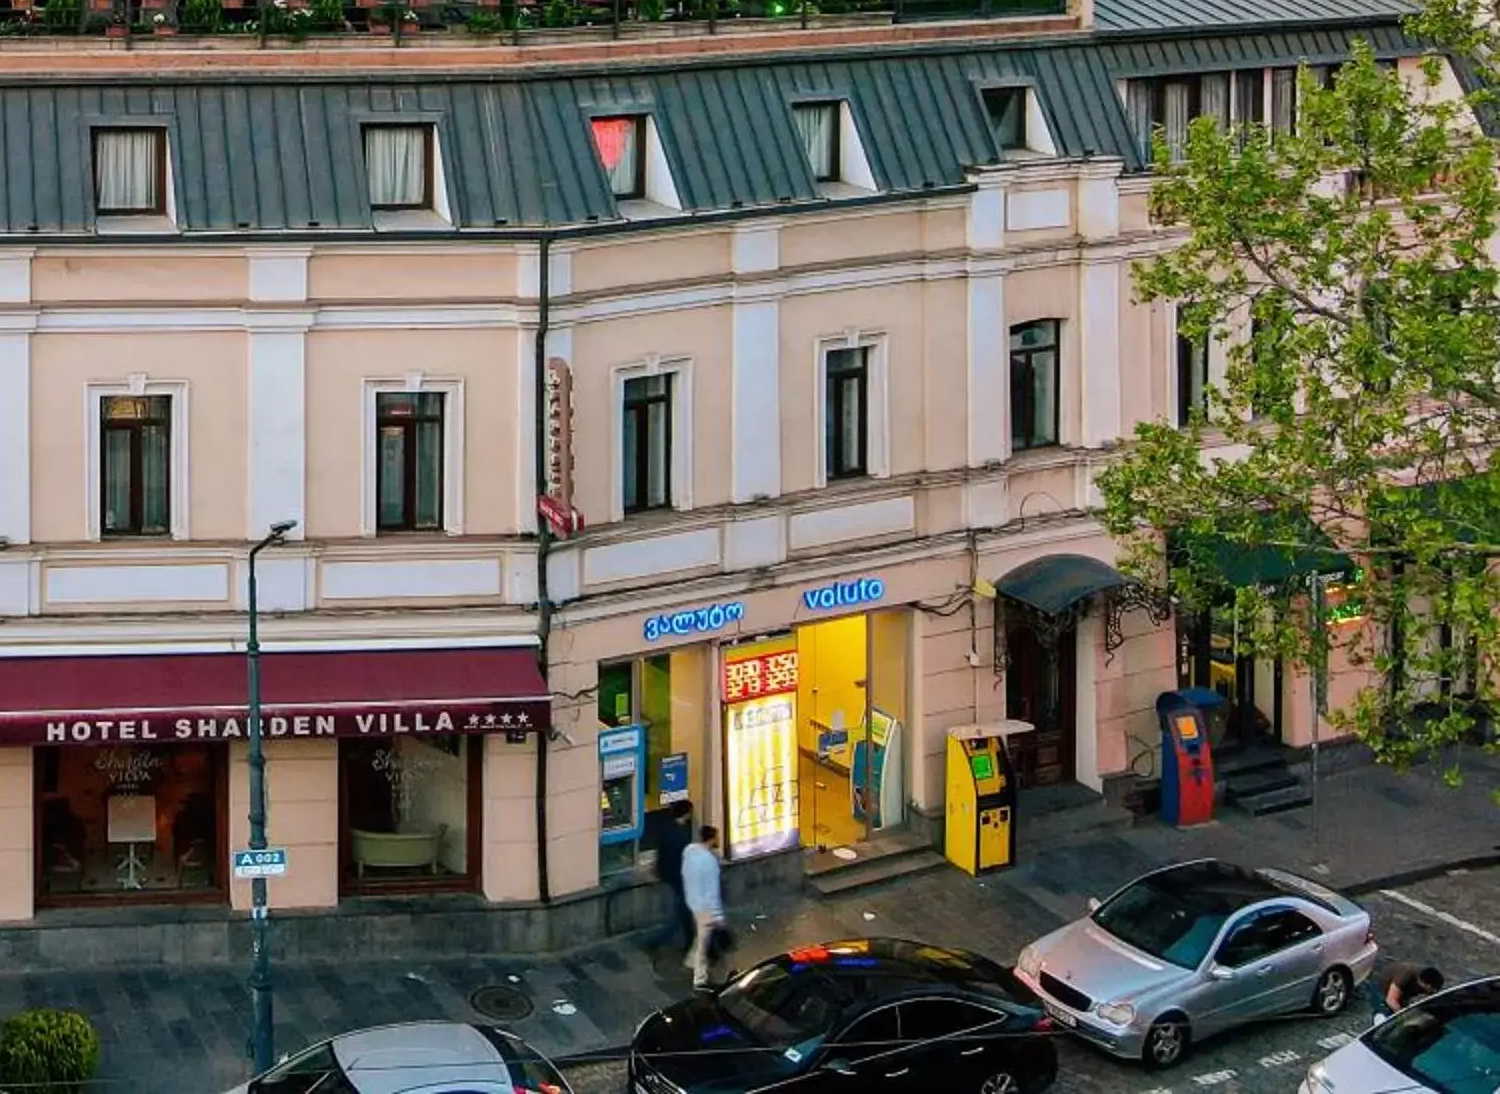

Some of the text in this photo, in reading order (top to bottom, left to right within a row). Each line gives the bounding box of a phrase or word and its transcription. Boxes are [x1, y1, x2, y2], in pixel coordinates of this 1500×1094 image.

[46, 720, 157, 741] HOTEL
[355, 712, 454, 733] VILLA
[241, 853, 253, 865] A
